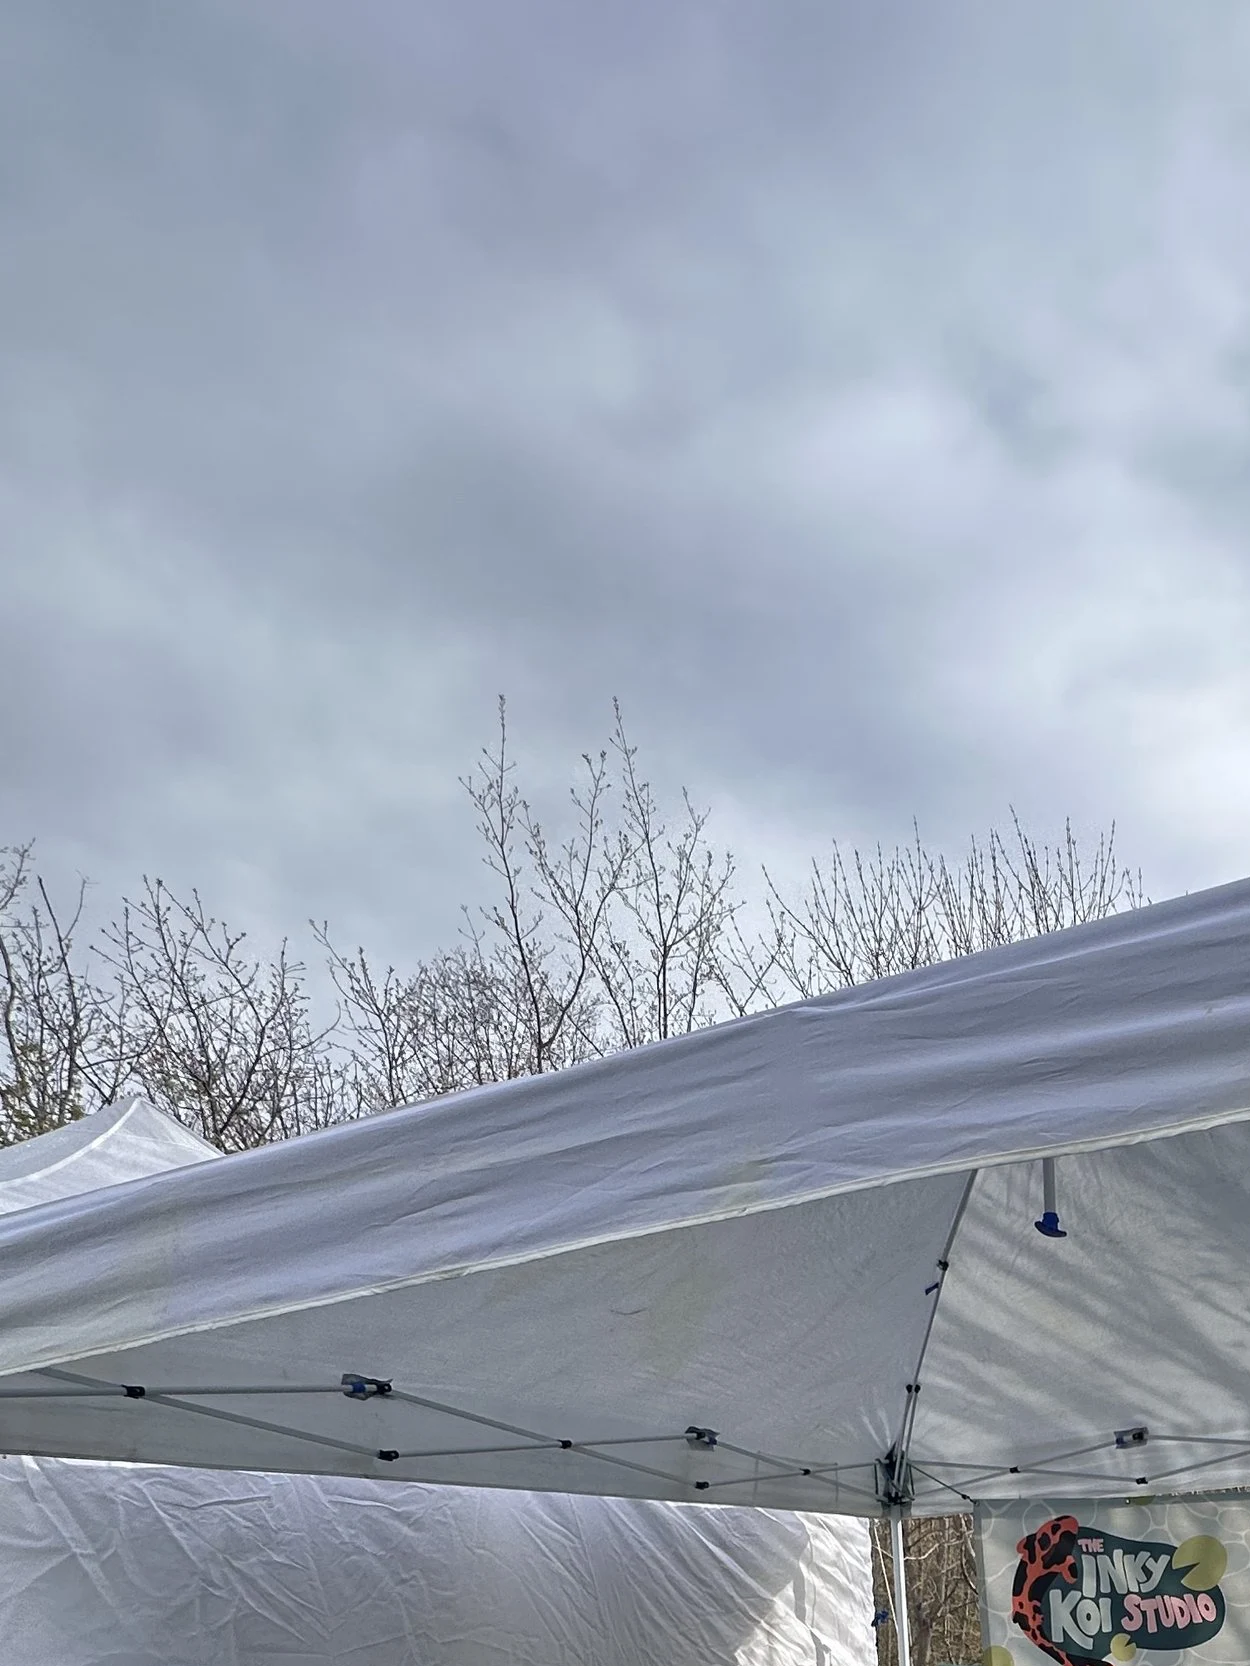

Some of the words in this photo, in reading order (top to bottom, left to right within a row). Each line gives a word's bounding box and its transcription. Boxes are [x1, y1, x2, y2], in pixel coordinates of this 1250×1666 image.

[1077, 1538, 1104, 1553] THE
[1081, 1549, 1171, 1599] INKY
[1049, 1588, 1113, 1650] KOI
[1120, 1592, 1217, 1634] STUDIO
